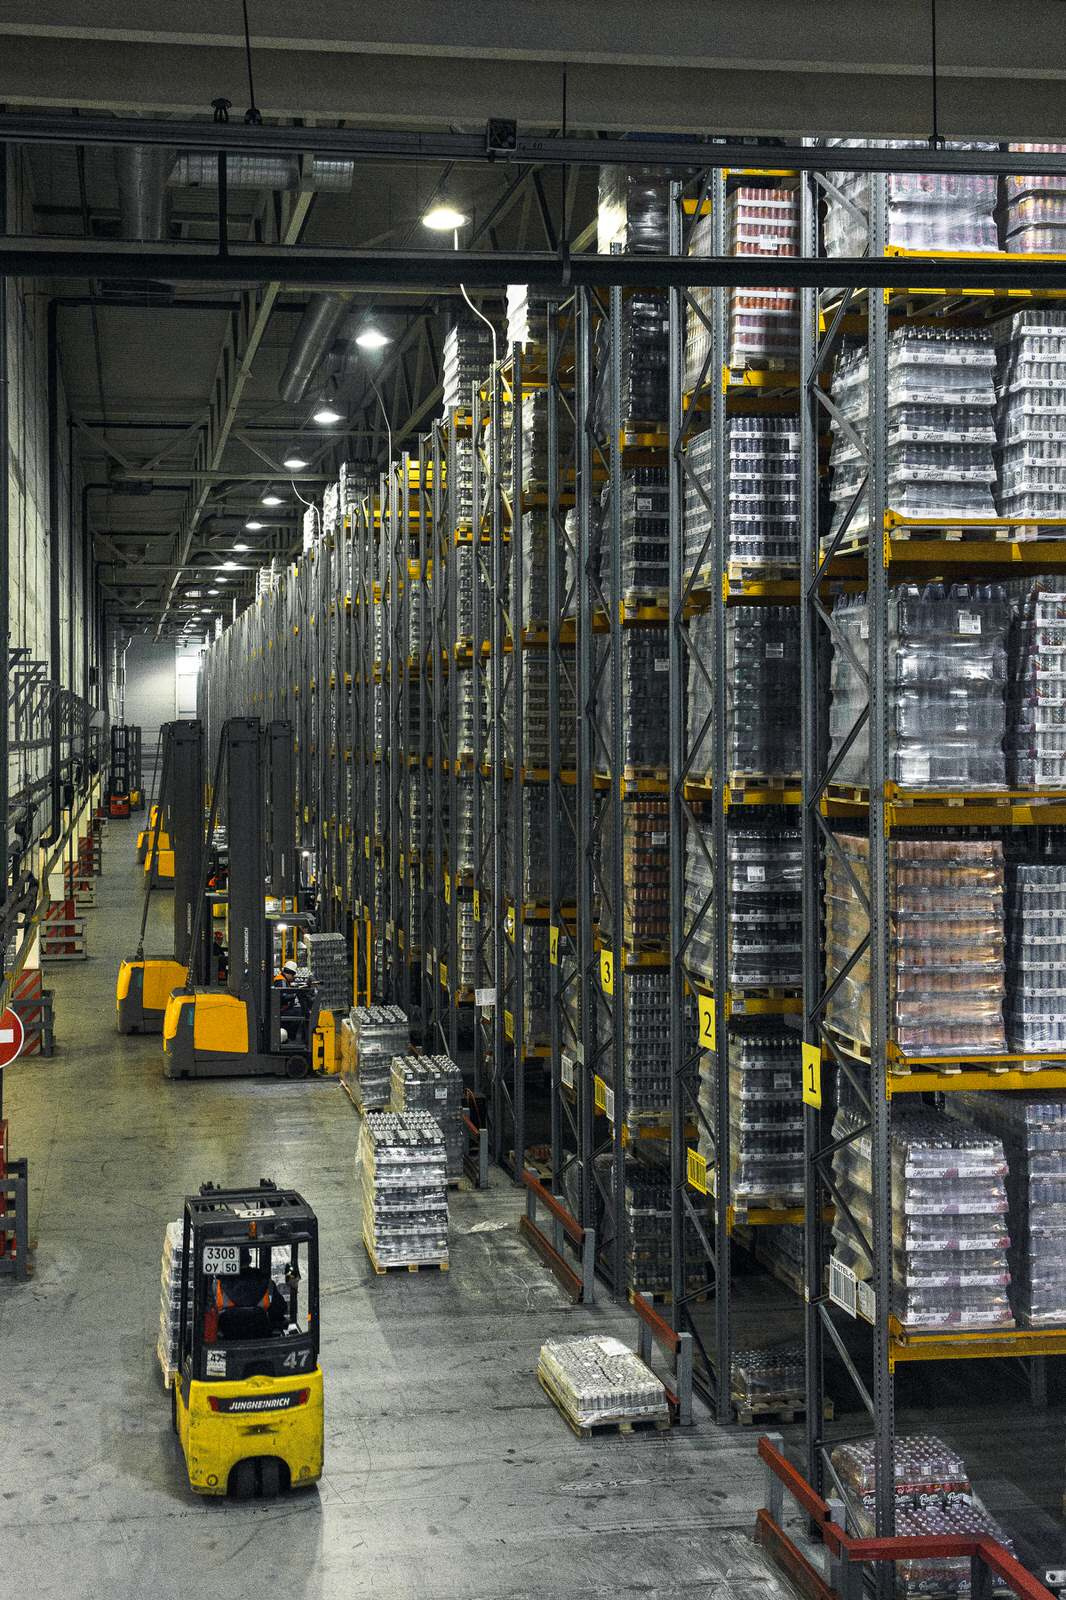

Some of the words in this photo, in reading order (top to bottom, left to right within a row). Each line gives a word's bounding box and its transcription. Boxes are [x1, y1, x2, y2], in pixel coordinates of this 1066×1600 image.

[551, 938, 557, 959] 4
[603, 960, 611, 984] 3
[704, 1011, 712, 1037] 2
[808, 1063, 817, 1094] 1
[206, 1247, 236, 1260] 3308
[225, 1263, 237, 1273] 50
[283, 1350, 310, 1368] 47
[229, 1398, 290, 1410] JUNGHEINRICH
